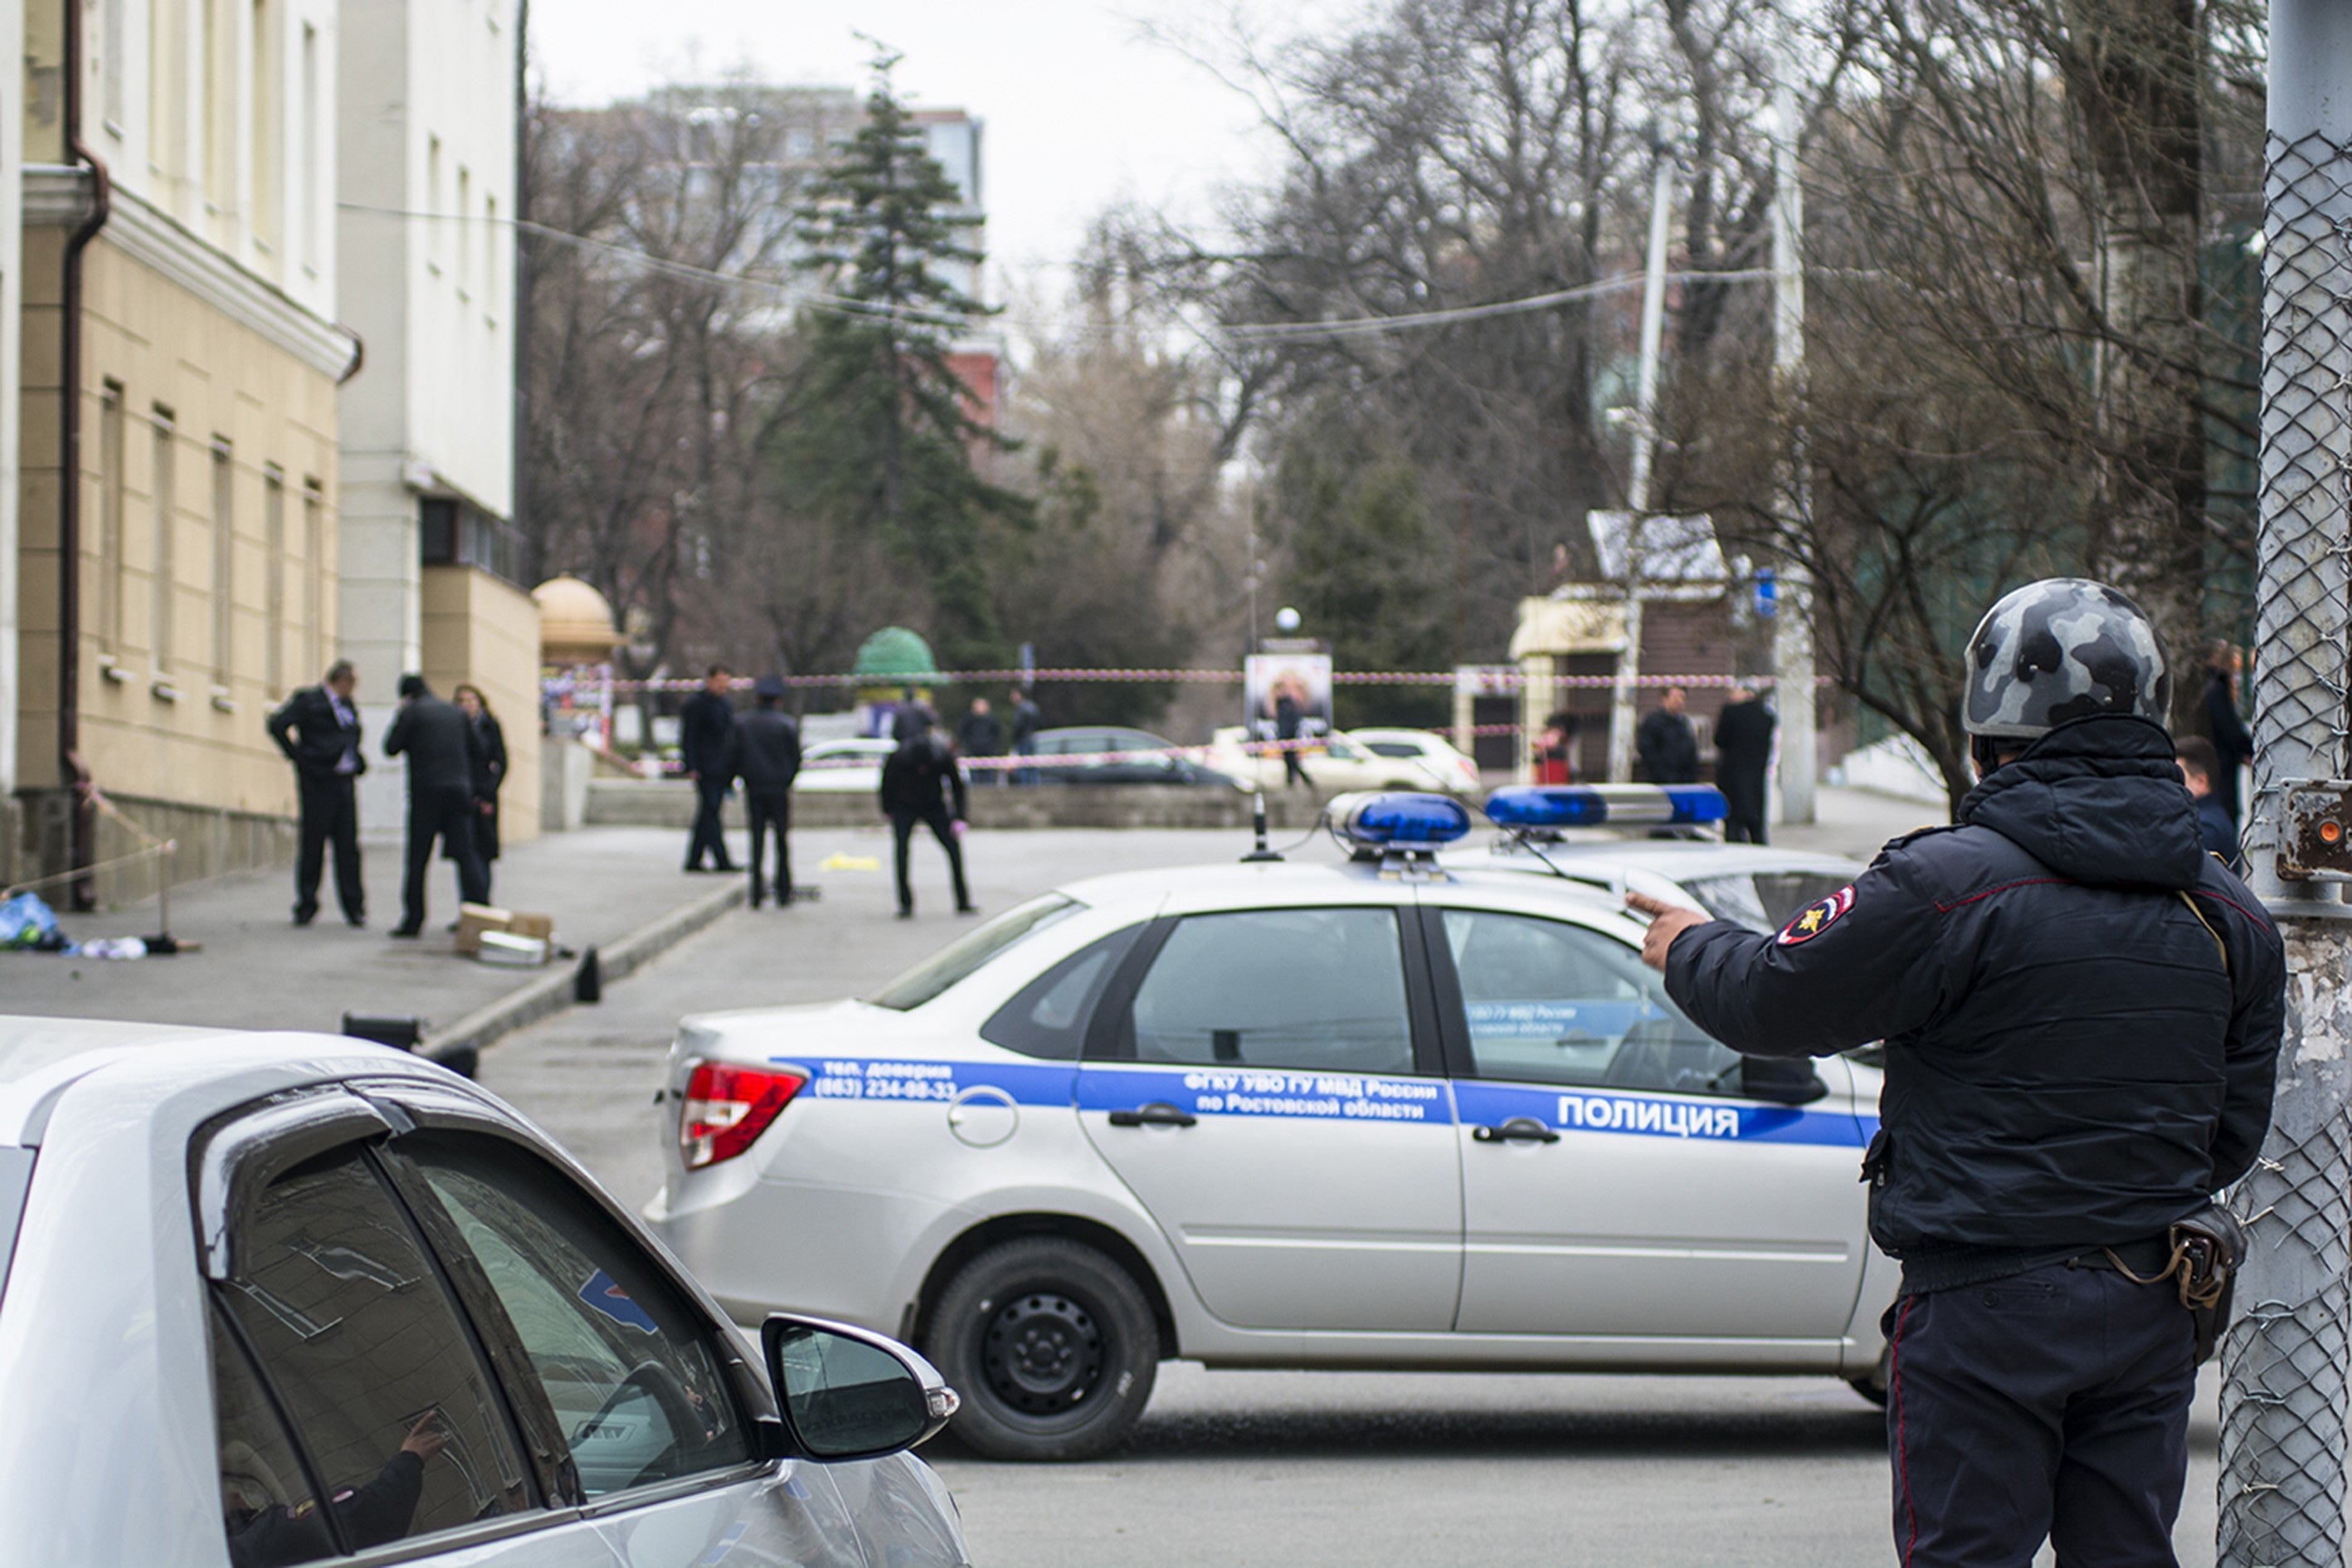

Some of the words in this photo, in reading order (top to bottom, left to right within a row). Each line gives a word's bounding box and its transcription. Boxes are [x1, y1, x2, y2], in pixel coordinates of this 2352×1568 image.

[1243, 1075, 1285, 1093] УВО
[1288, 1076, 1313, 1094] ГУ
[1316, 1078, 1363, 1098] МВД
[1365, 1079, 1438, 1100] России
[1196, 1096, 1224, 1111] по
[1226, 1093, 1341, 1117] Ростовской
[1342, 1098, 1424, 1119] области
[1558, 1096, 1739, 1138] ПОЛИЦИЯ
